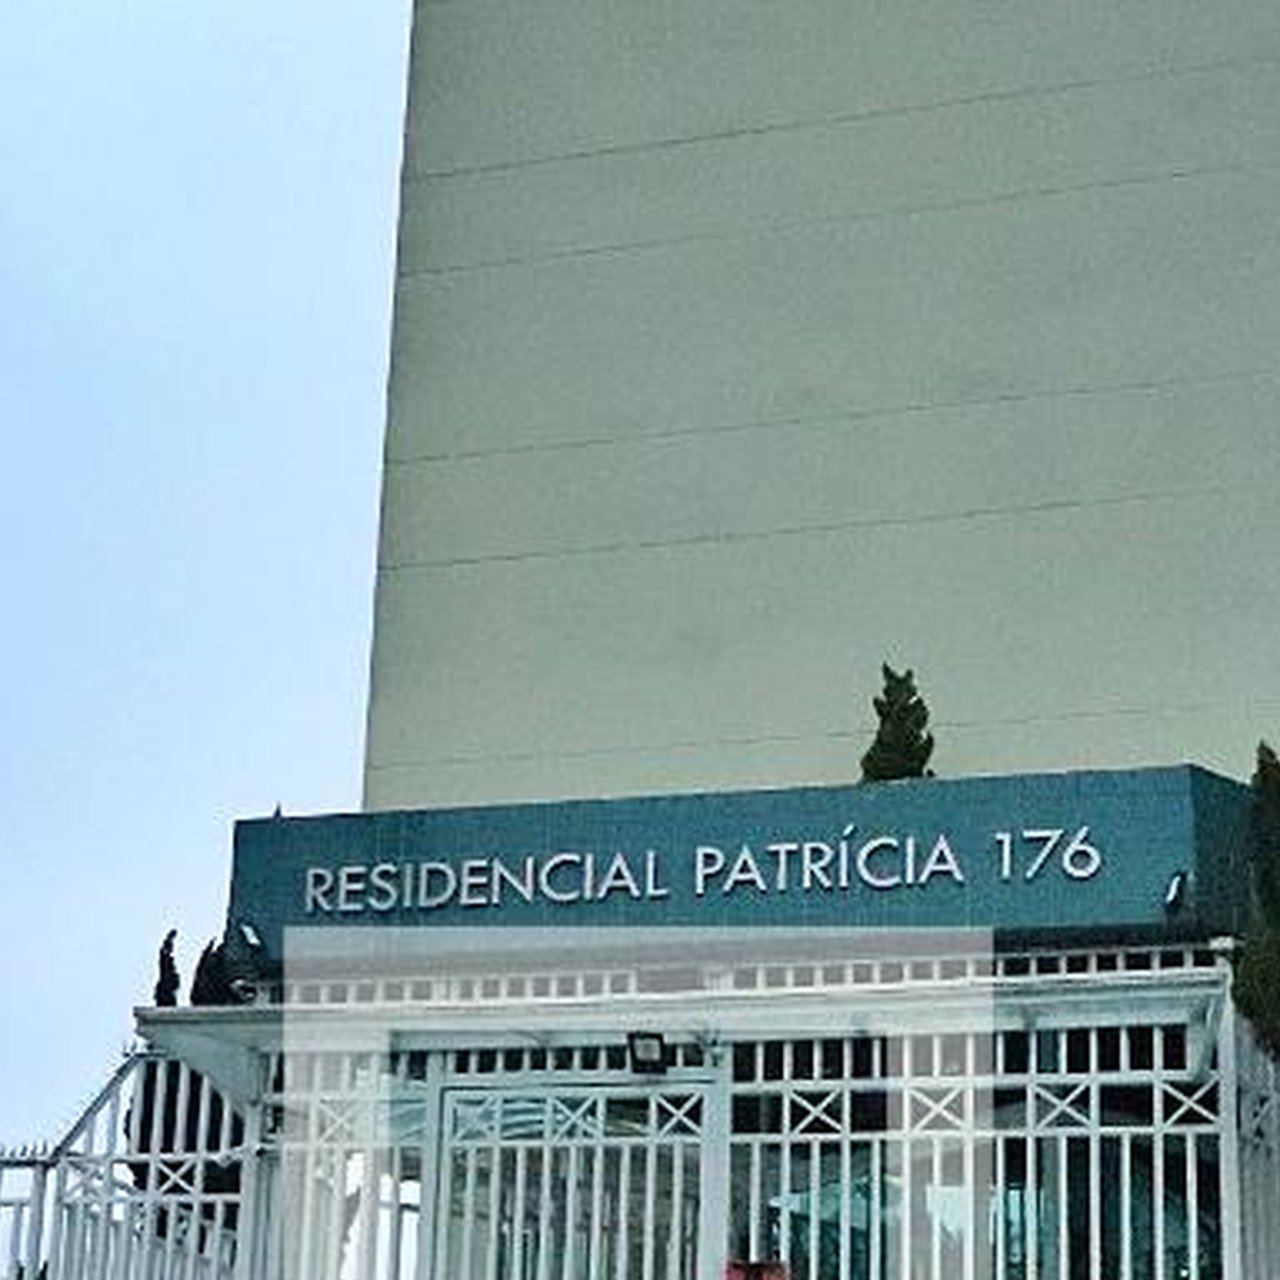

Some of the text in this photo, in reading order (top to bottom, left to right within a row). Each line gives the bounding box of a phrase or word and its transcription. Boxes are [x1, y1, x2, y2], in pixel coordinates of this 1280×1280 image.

[304, 823, 1102, 914] RESIDENCIAL PATRÍCIA 176
